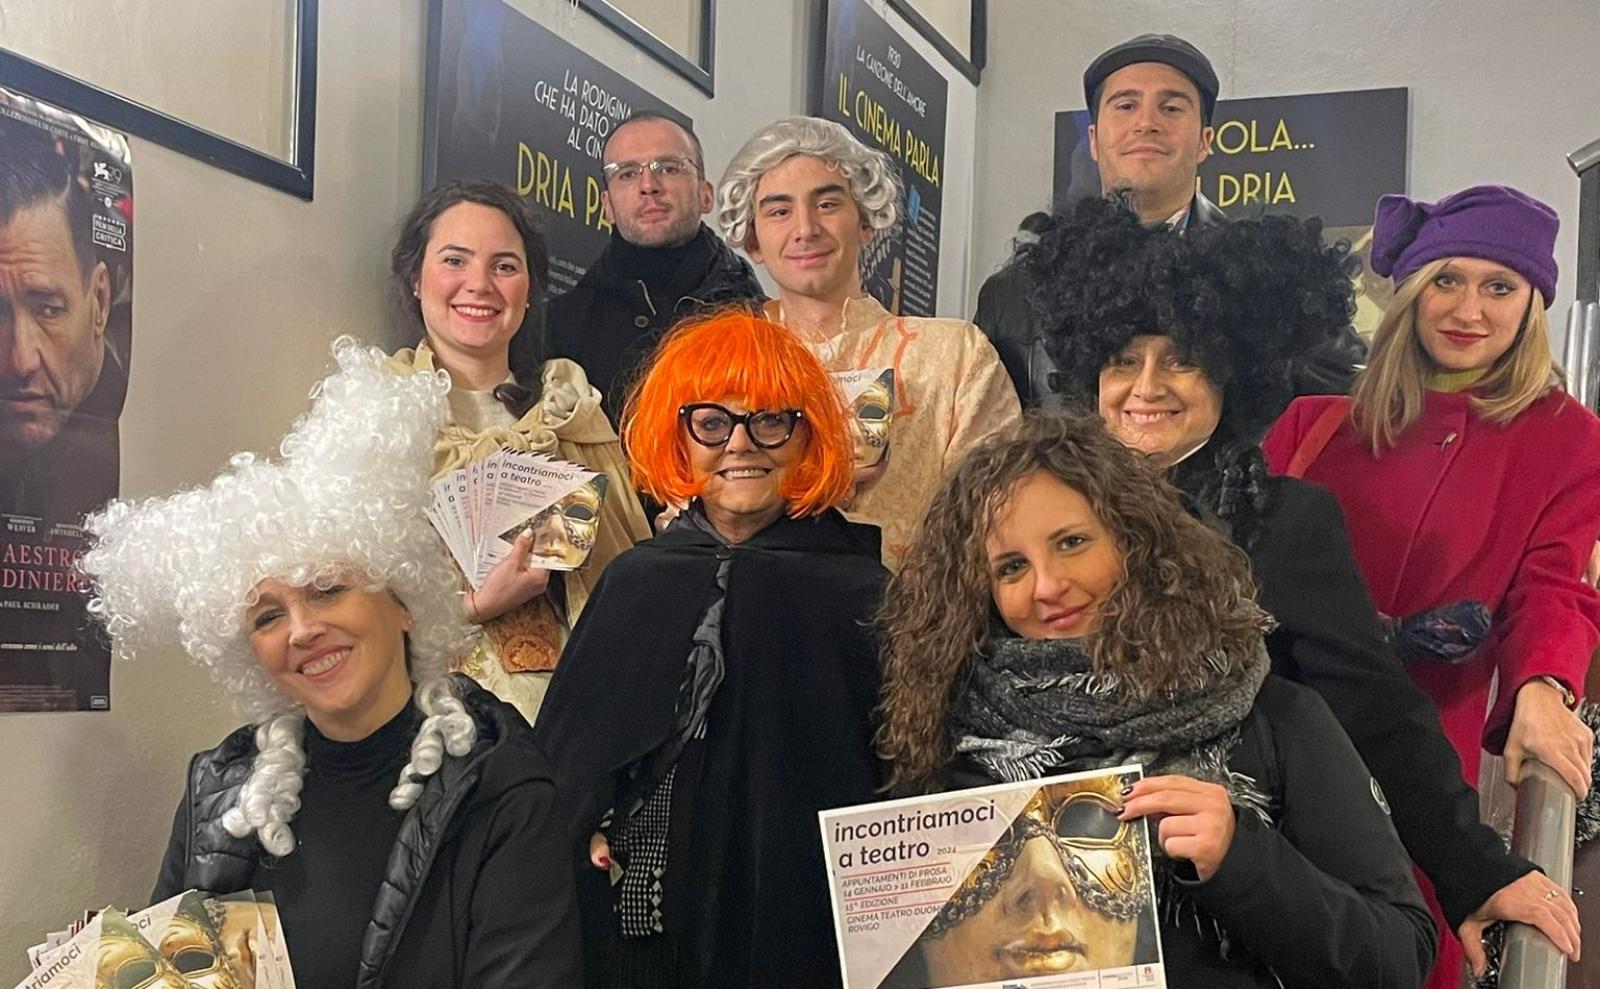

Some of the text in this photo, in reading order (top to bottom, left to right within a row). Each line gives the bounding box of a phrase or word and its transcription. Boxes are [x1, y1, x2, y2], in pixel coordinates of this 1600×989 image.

[857, 45, 865, 64] LA
[564, 69, 631, 120] LA RODIGINA
[534, 81, 609, 138] CHE HA DATO
[567, 126, 581, 151] AL
[838, 73, 939, 188] IL CINEMA PARLA
[1216, 118, 1315, 155] OLA...
[517, 141, 575, 219] DRIA
[1218, 171, 1296, 208] DRIA
[95, 231, 122, 246] CRITICA
[501, 459, 575, 481] incontriamoci
[510, 472, 542, 487] teatro
[834, 799, 995, 843] incontriamoci
[838, 852, 853, 868] a
[860, 841, 930, 866] teatro
[842, 867, 947, 888] APPUNTAMENTI DI PROSA
[854, 883, 893, 896] GENNAIO
[847, 904, 940, 925] CINEMA TEATRO DUOM
[861, 897, 898, 909] EDIZIONE
[848, 922, 880, 934] ROVIGO
